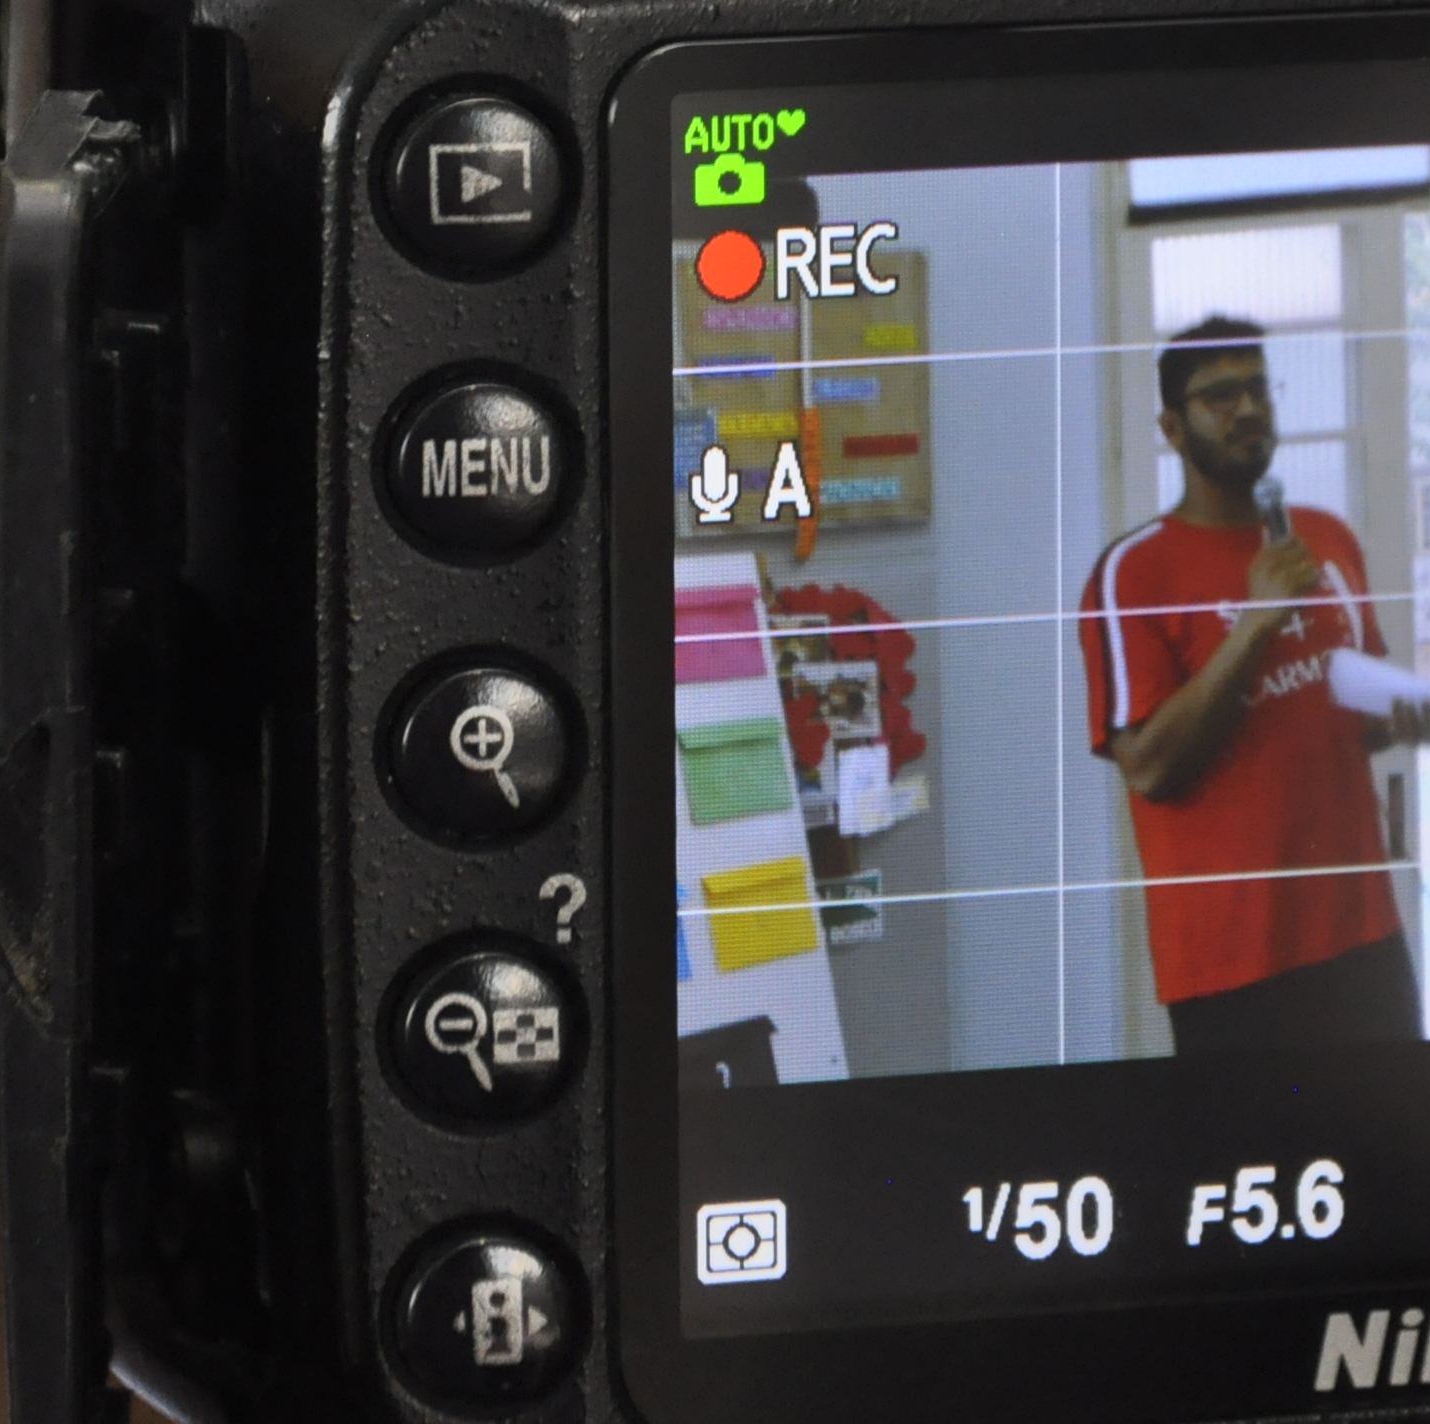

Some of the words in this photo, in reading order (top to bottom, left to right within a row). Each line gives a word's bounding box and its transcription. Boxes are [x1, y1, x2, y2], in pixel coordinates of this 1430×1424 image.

[684, 114, 774, 154] AUTO
[775, 221, 899, 300] REC
[422, 435, 550, 498] MENU
[762, 440, 812, 521] A
[962, 1175, 1115, 1261] 1/50
[1186, 1159, 1345, 1246] F5.6
